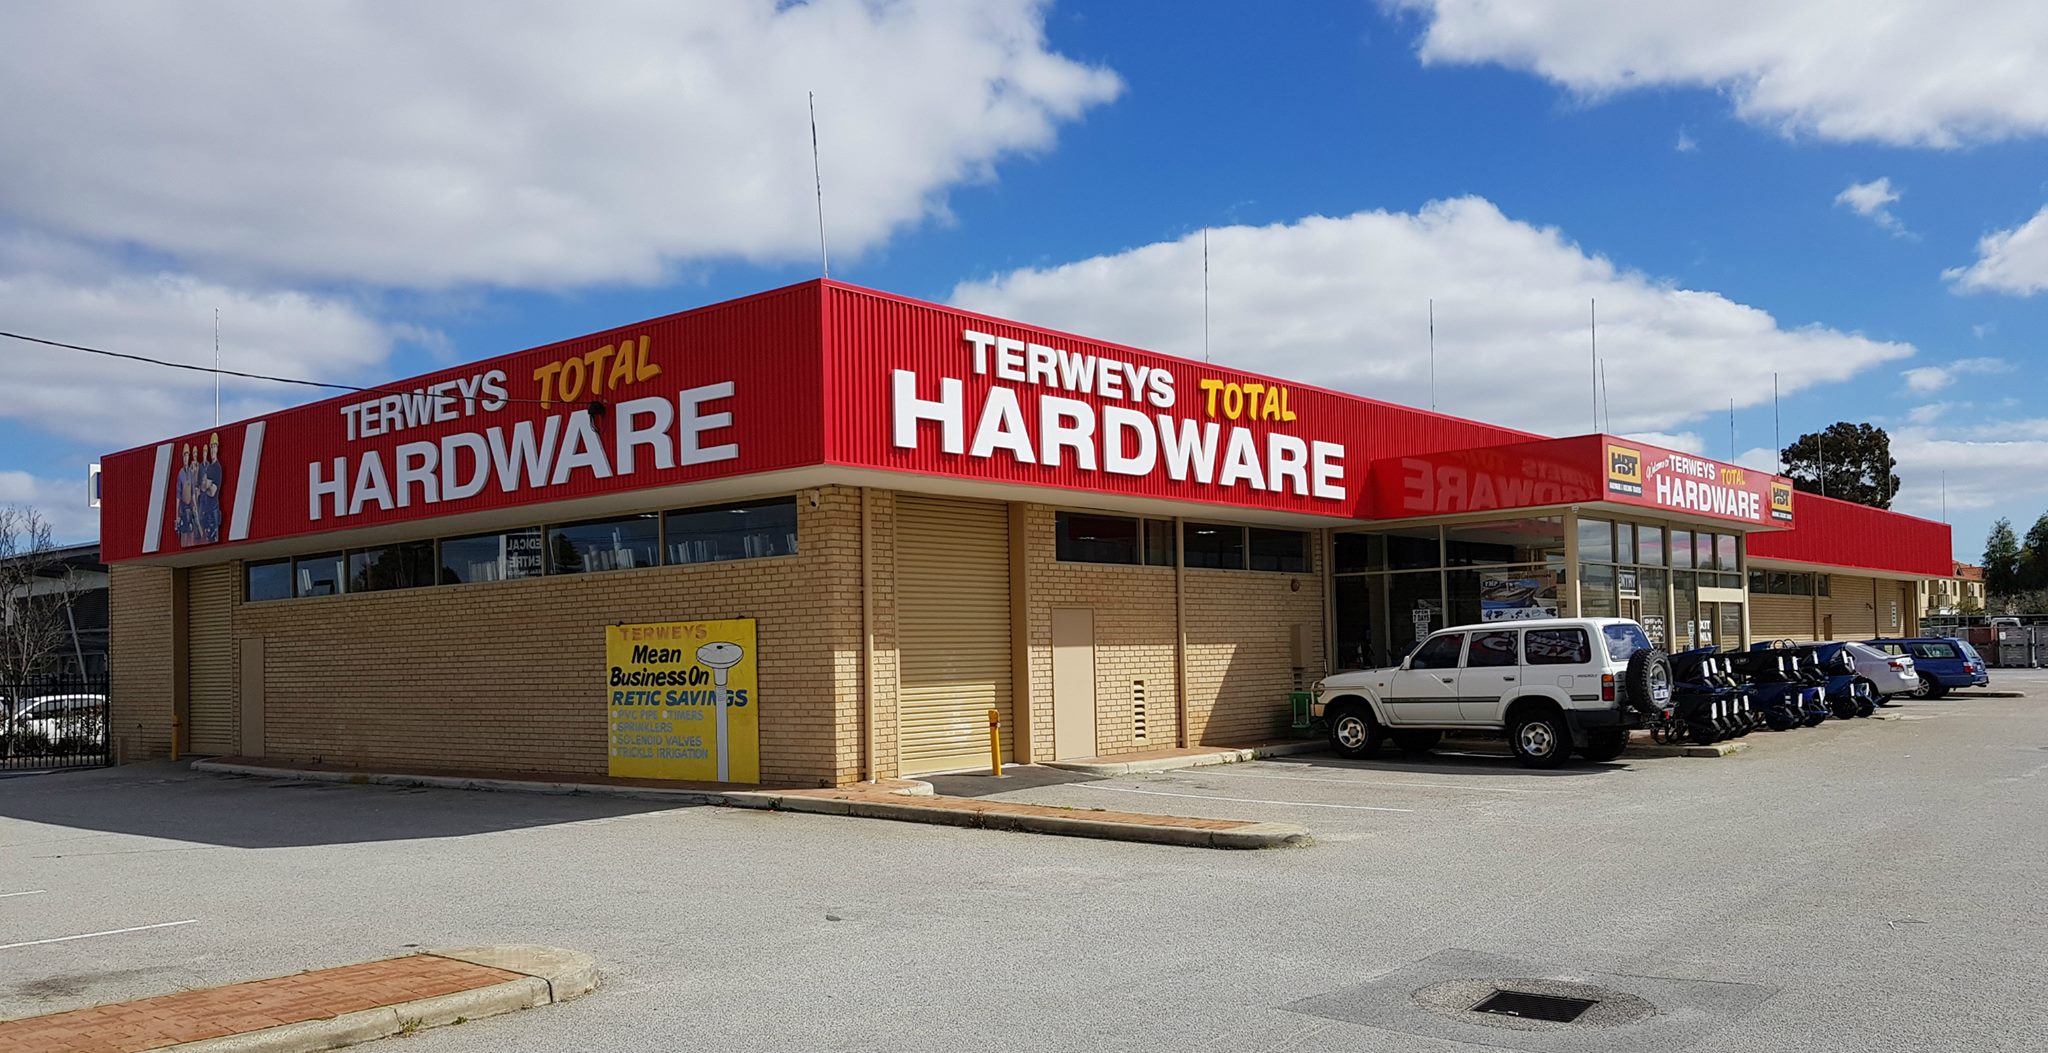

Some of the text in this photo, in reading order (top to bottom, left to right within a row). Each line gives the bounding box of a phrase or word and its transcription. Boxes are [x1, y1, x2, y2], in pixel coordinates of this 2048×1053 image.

[963, 329, 1297, 422] TERWEYS TOTAL
[340, 334, 662, 441] TERWEYS TOTAL
[891, 368, 1346, 501] HARDWARE
[309, 380, 739, 521] HARDWARE
[1669, 454, 1716, 480] TERWEYS
[1720, 468, 1746, 485] TOTAL
[1656, 474, 1760, 520] HARDWARE
[618, 624, 708, 641] TERWEYS
[631, 645, 682, 664] Mean
[610, 665, 710, 687] Business On
[640, 710, 658, 720] PIPE
[667, 710, 704, 721] TIMERS
[618, 722, 673, 732] SPRINKLERS
[618, 735, 702, 747] SOLENOID VALVES
[618, 747, 709, 759] TRICKLE IRRIGATION
